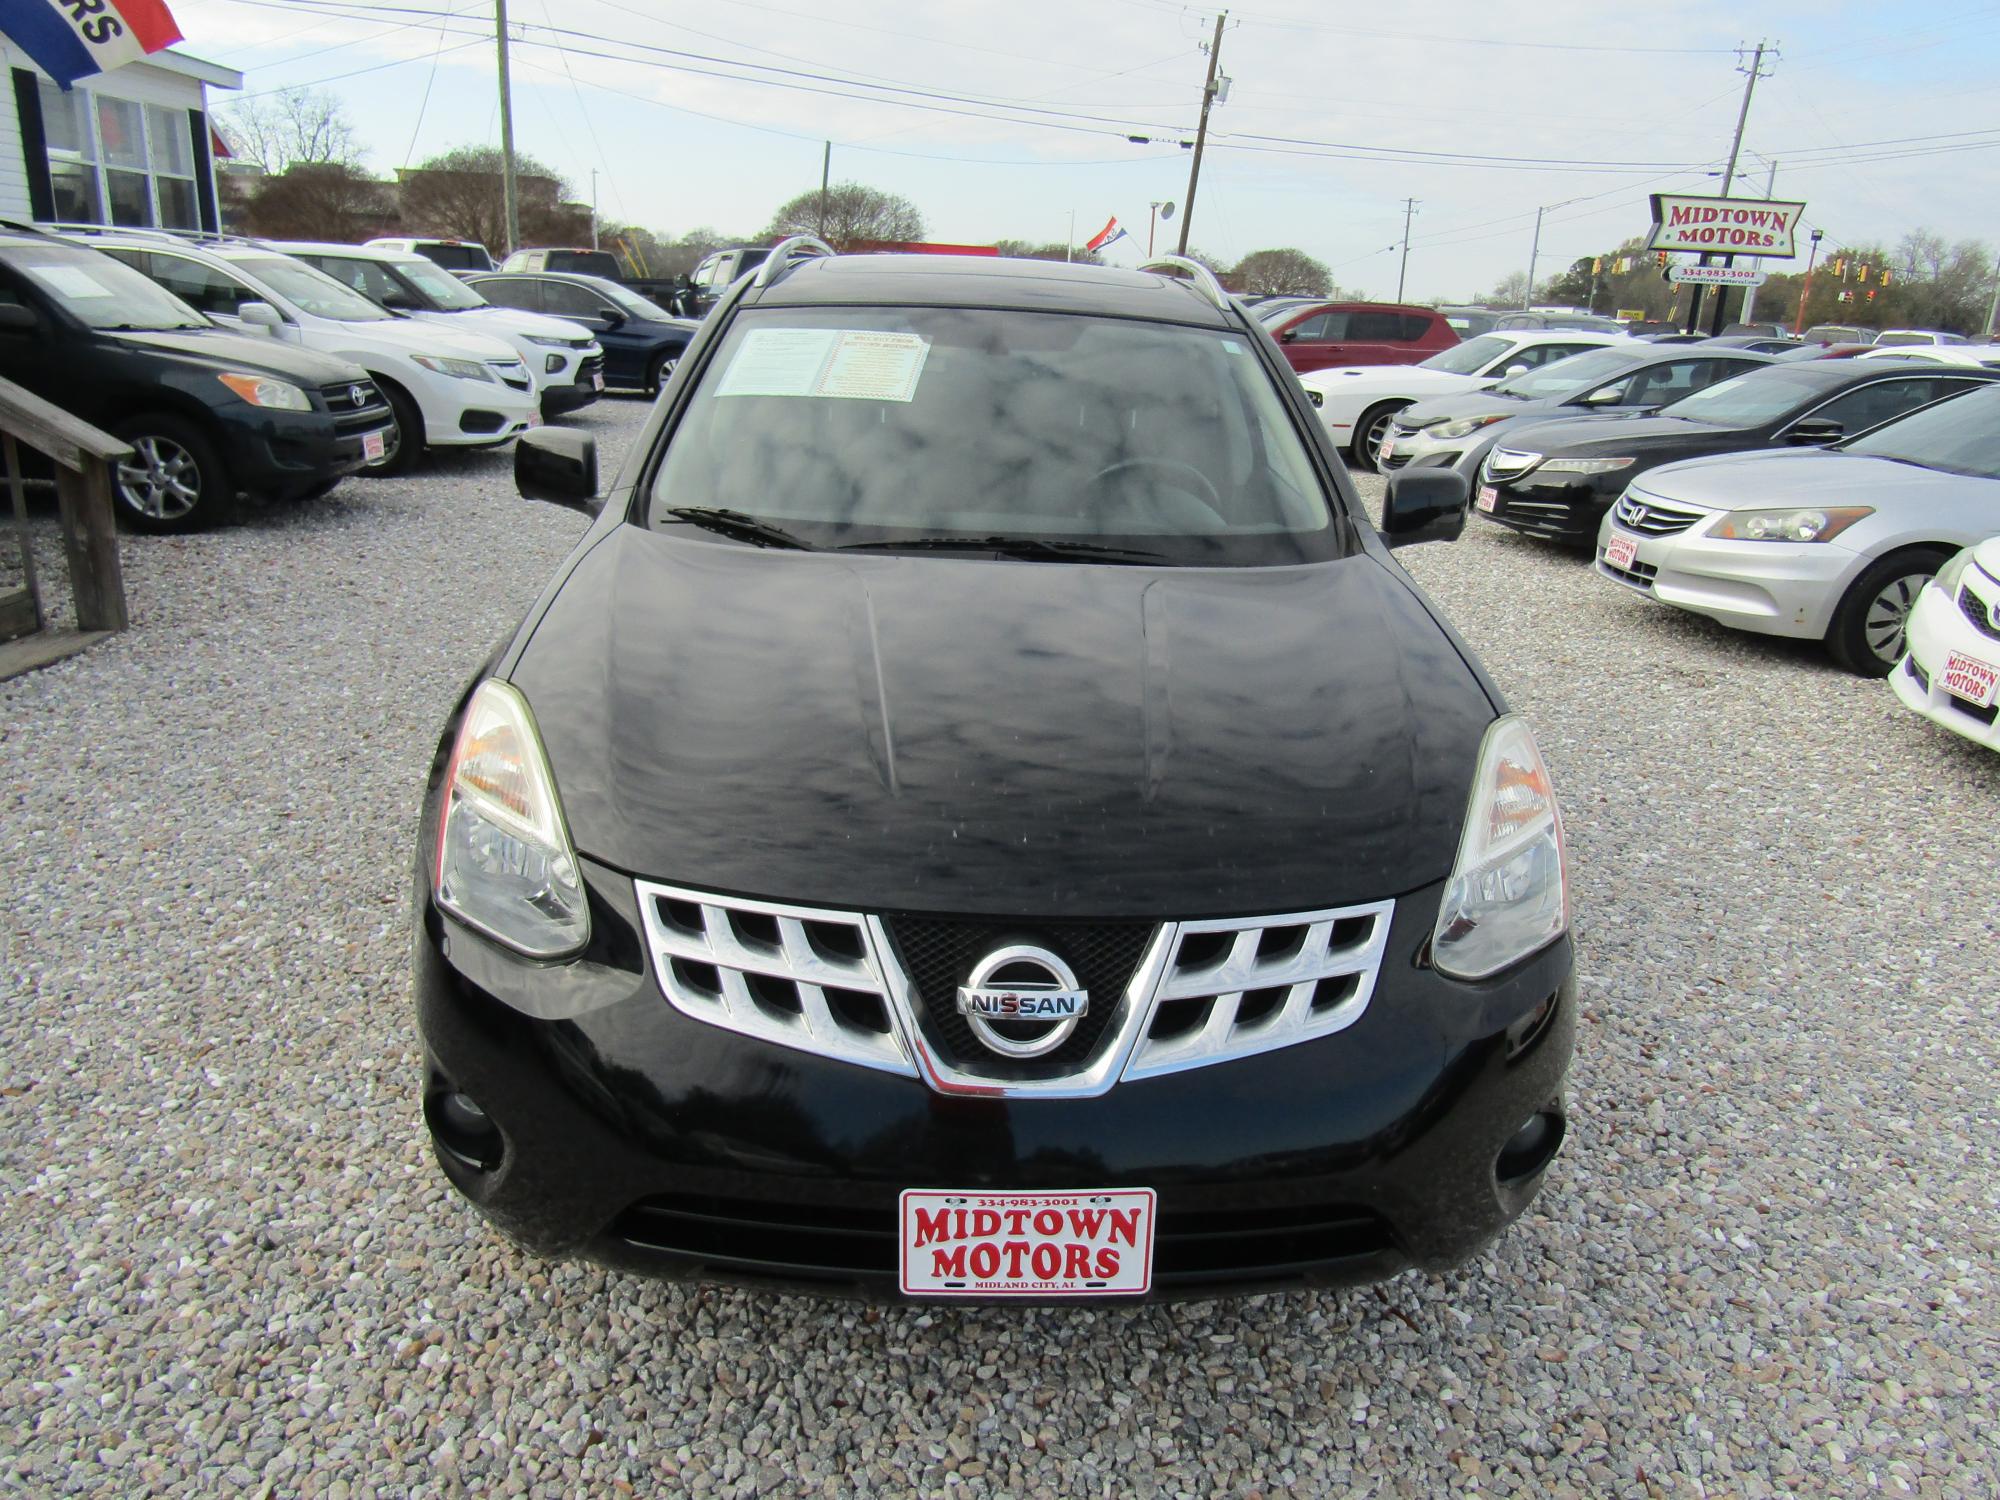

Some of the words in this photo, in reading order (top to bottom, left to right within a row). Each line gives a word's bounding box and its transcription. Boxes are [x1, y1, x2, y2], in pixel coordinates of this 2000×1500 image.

[1668, 205, 1789, 233] MIDTOWN
[1676, 227, 1774, 247] MOTORS
[1682, 268, 1756, 278] 334-983-3001
[1947, 656, 1998, 688] MIDTOWN
[1946, 672, 1987, 698] MOTORS
[971, 994, 1075, 1014] NISSAN
[977, 1198, 1079, 1207] 334-983-3001
[913, 1207, 1142, 1248] MIDTOWN
[930, 1240, 1121, 1280] MOTORS
[974, 1281, 1029, 1289] MIDLAND
[1031, 1281, 1060, 1290] CITY,
[1061, 1281, 1077, 1289] AL
